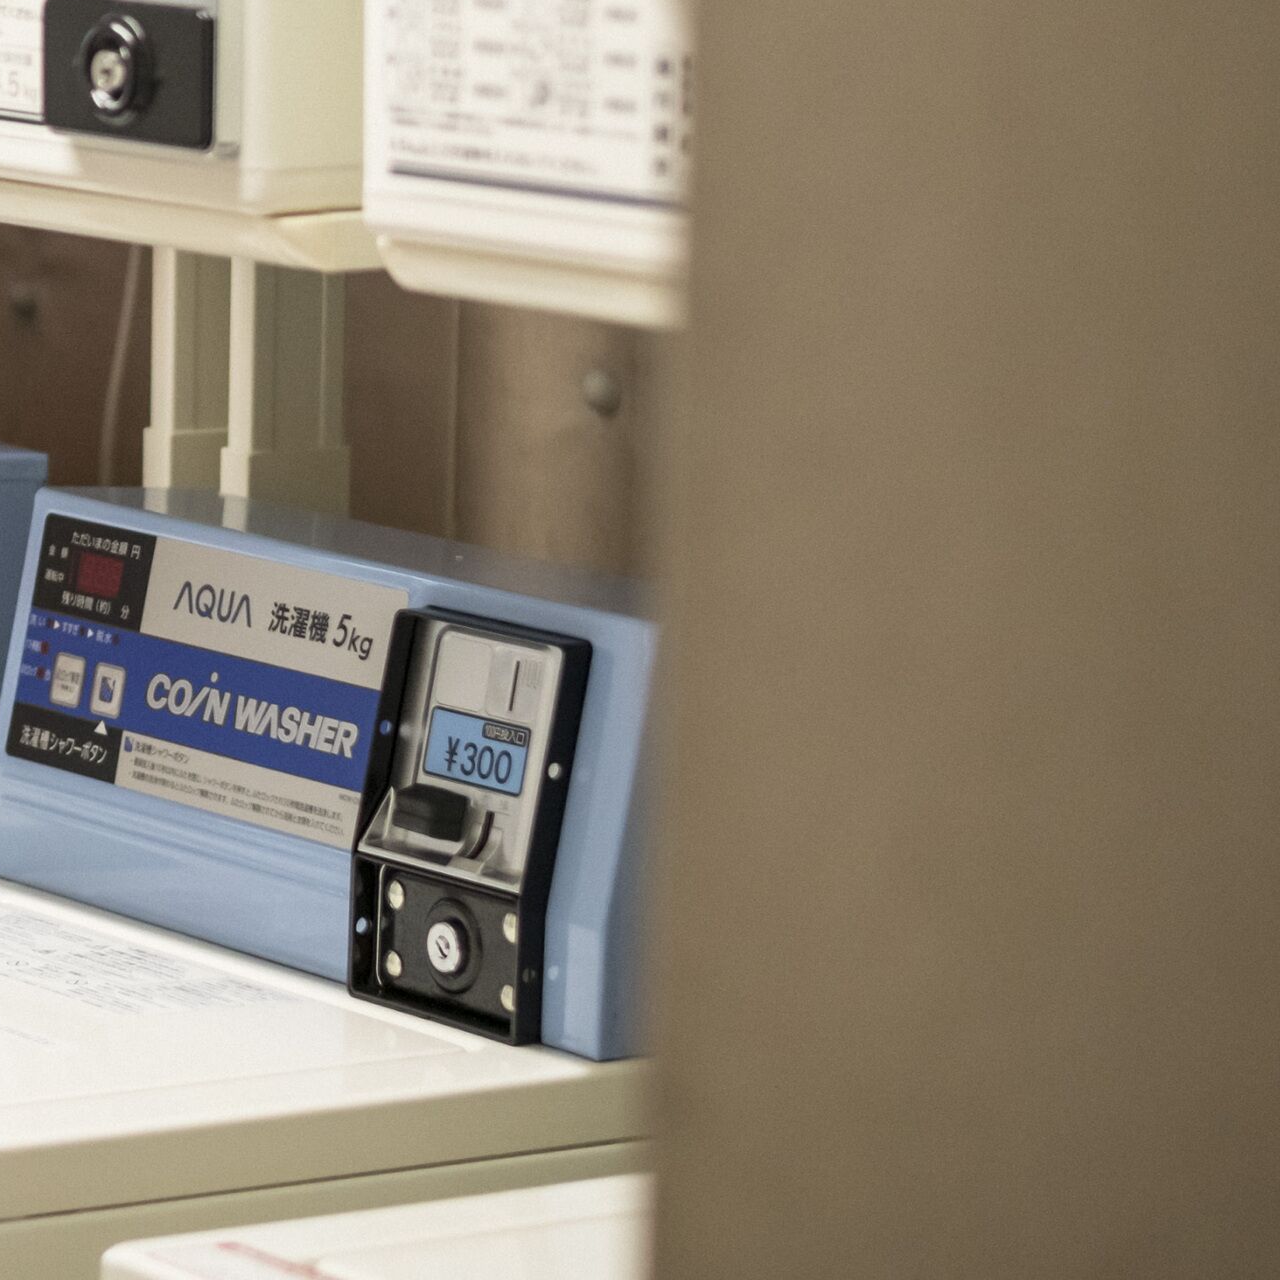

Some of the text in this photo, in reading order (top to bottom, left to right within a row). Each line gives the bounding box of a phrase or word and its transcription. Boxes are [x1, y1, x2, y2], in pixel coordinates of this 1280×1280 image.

[71, 531, 141, 560] ただいまの金額 円
[120, 605, 130, 620] 分
[173, 580, 374, 661] AQUA 洗濯機 5kg
[146, 672, 359, 759] COIN WASHER
[444, 735, 513, 785] ¥300
